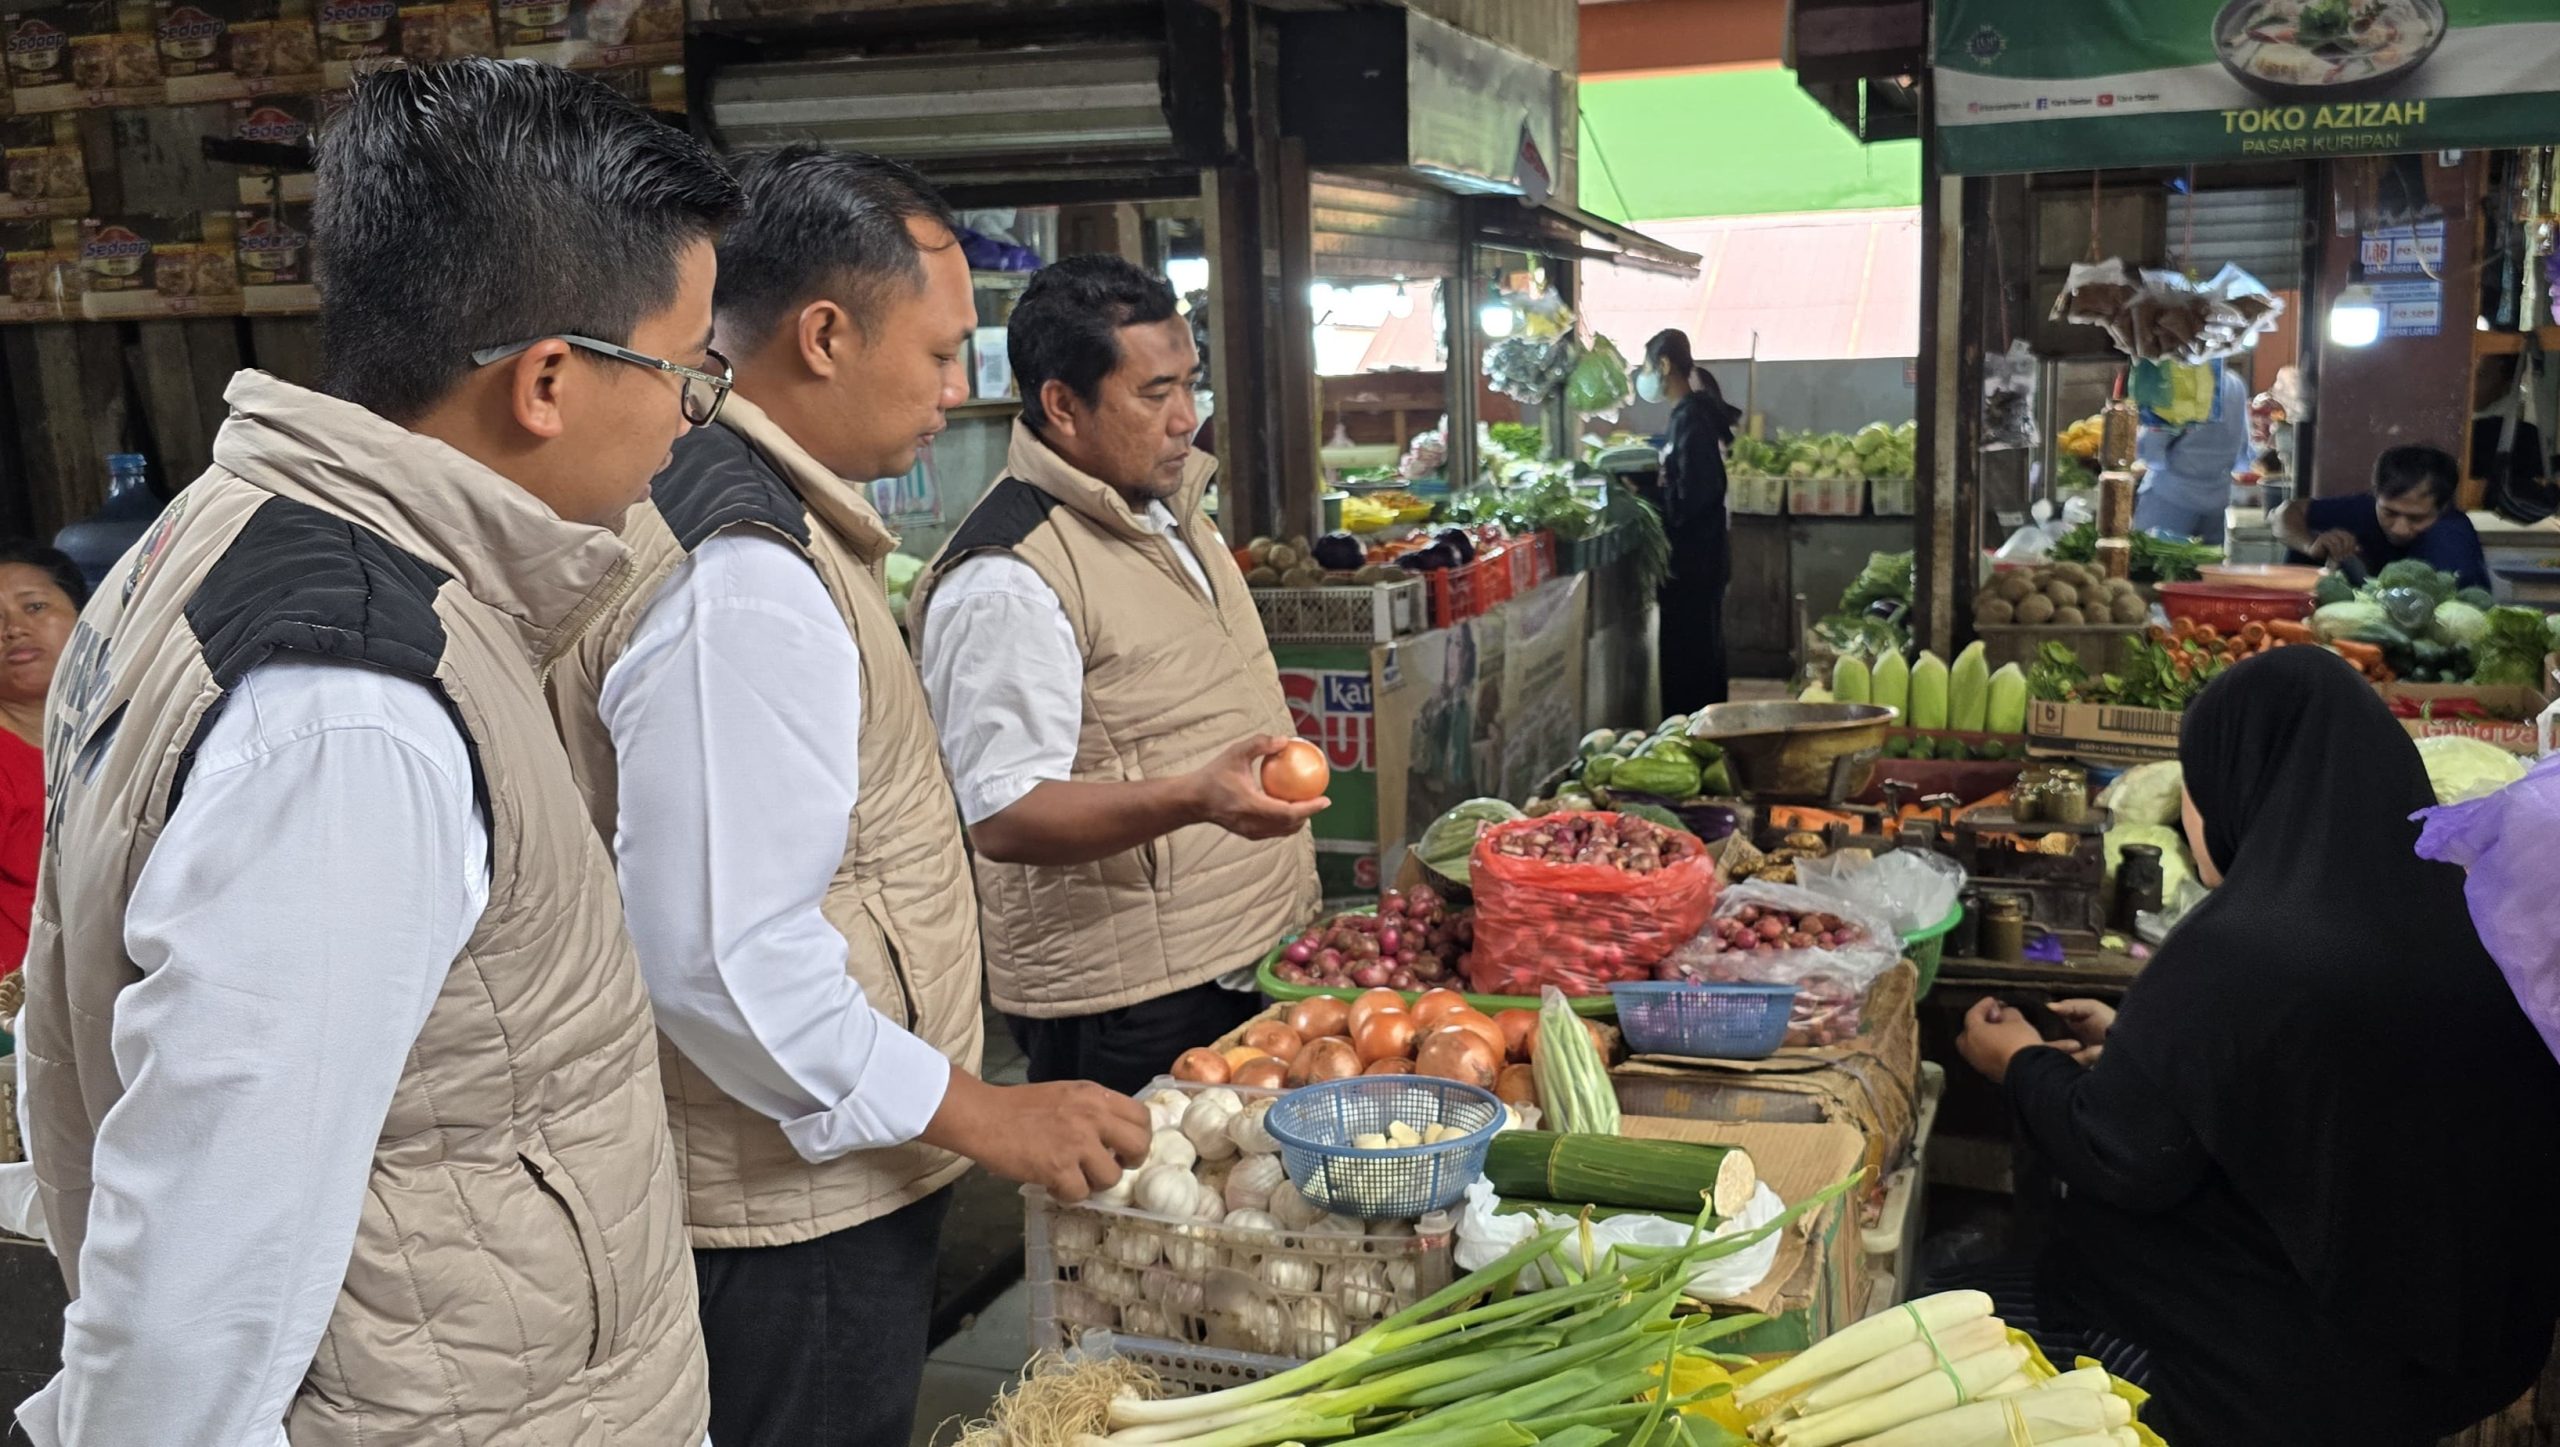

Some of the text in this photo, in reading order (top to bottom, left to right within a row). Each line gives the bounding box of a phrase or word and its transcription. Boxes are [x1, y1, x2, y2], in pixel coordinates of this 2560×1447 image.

[323, 4, 395, 21] Sedaap
[159, 20, 224, 39] Sedaap
[8, 33, 65, 52] Sedaap
[2221, 100, 2426, 134] TOKO AZIZAH
[2242, 132, 2400, 155] PASAR KURIPAN
[85, 241, 150, 257] Sedaap
